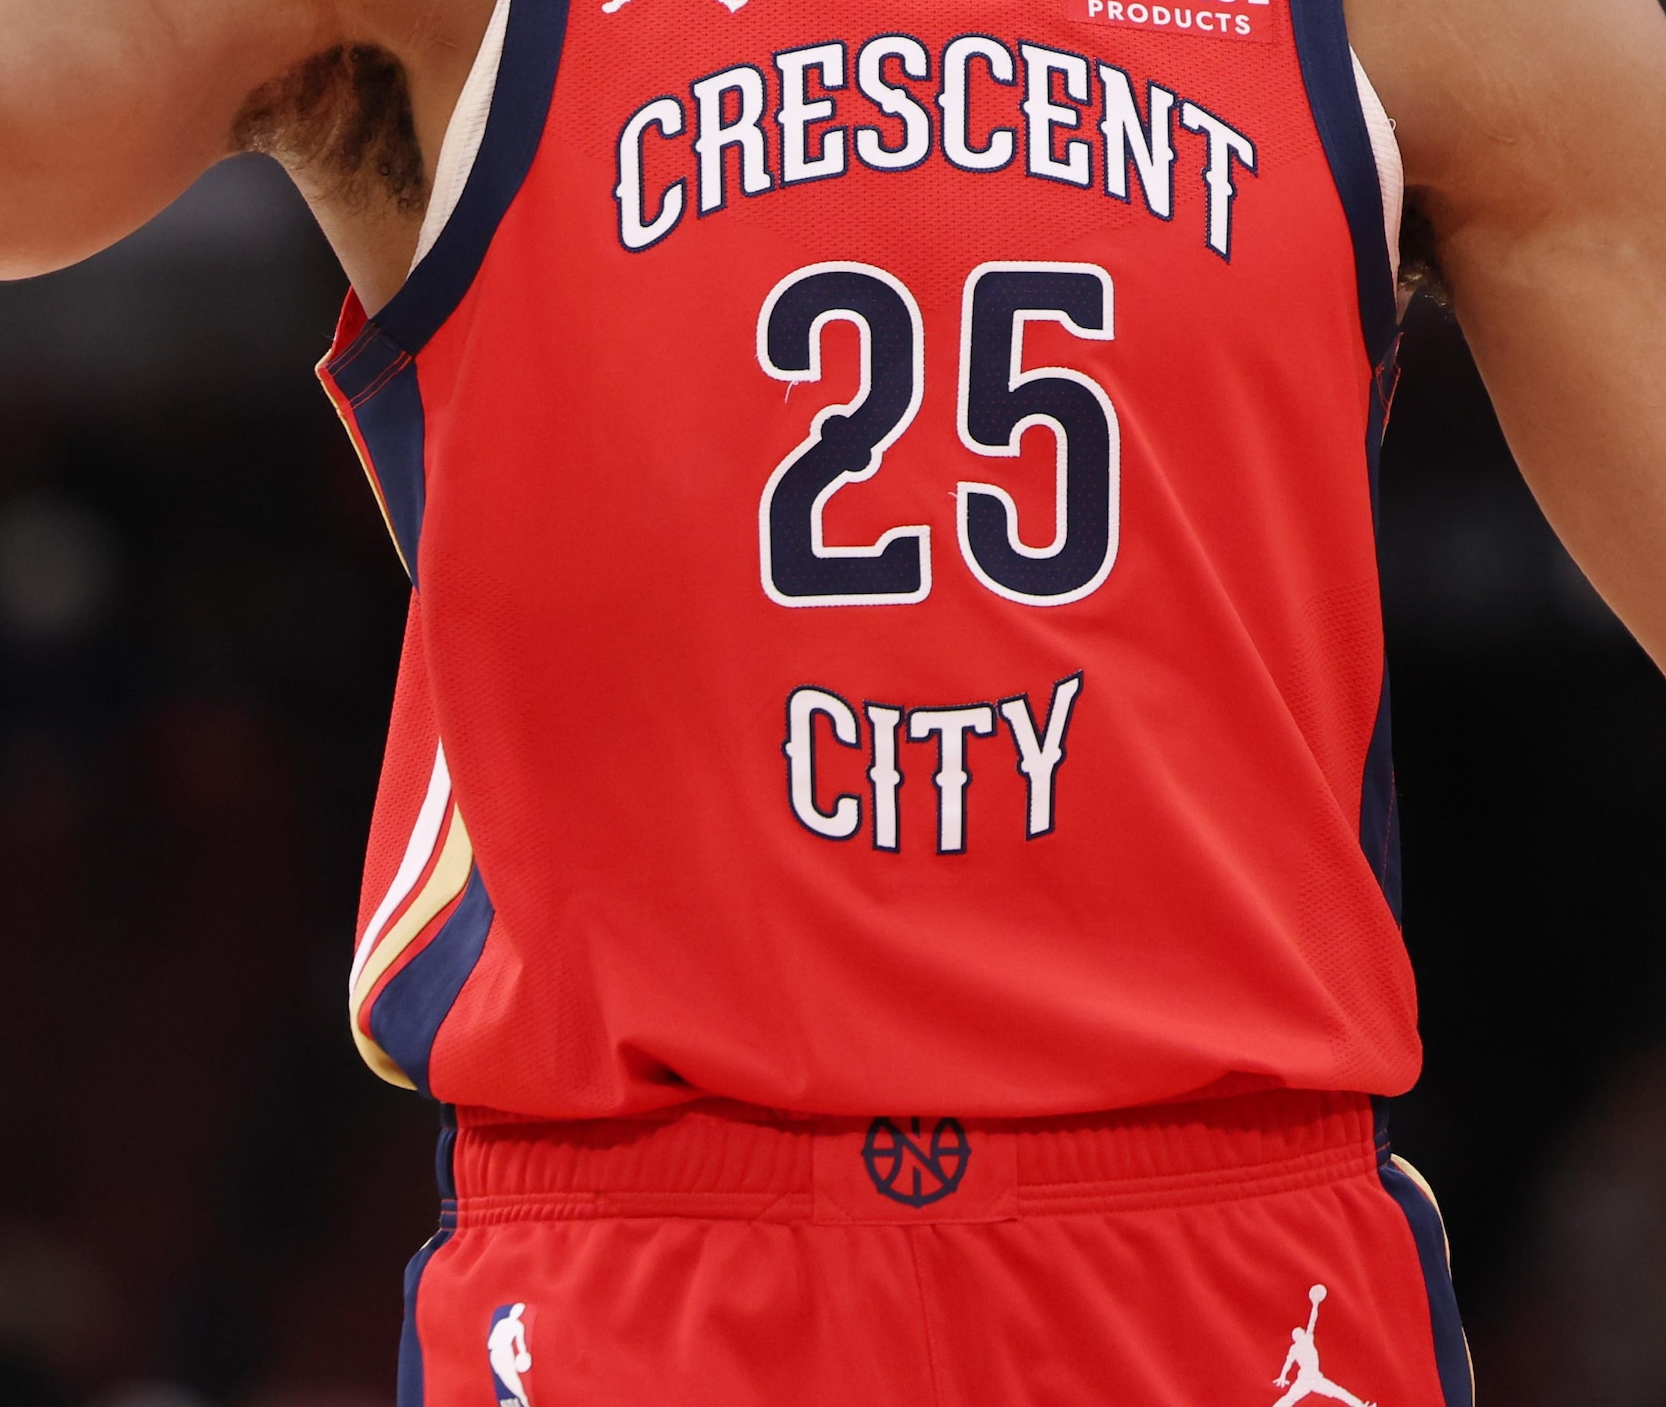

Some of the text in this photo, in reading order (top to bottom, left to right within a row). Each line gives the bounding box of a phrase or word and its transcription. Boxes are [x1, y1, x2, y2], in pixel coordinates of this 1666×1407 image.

[614, 33, 1258, 262] CRESCENT
[756, 261, 1121, 608] 25
[781, 670, 1084, 855] CITY
